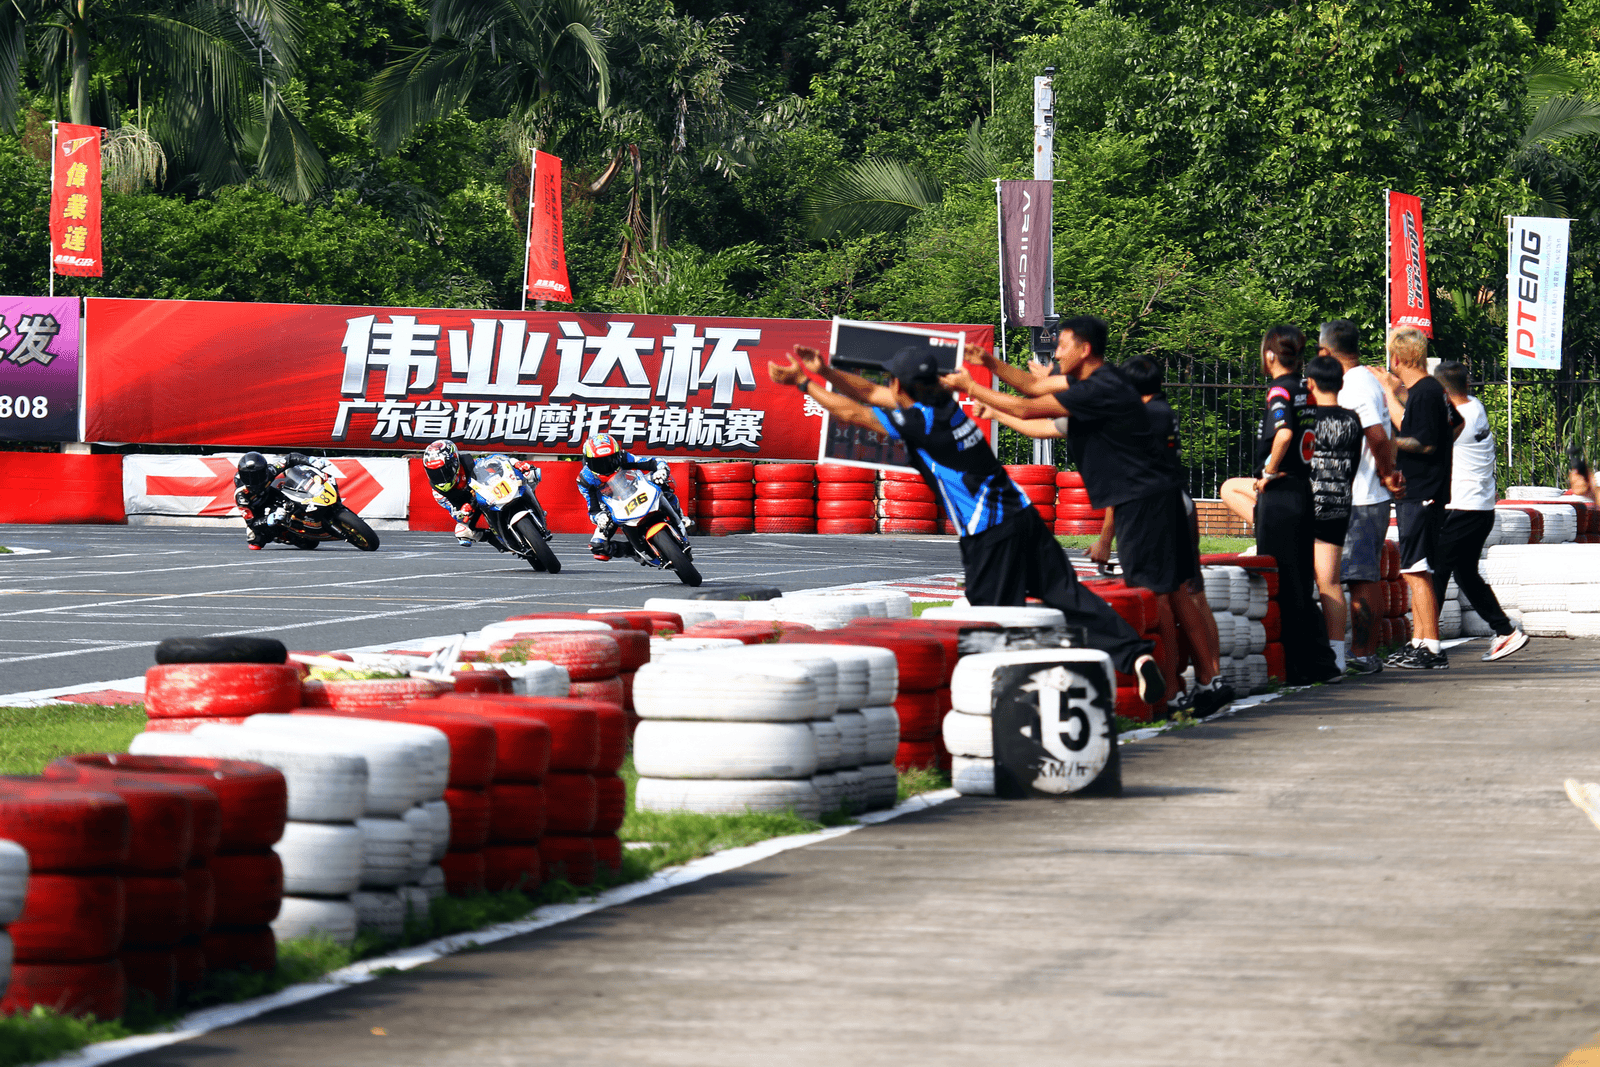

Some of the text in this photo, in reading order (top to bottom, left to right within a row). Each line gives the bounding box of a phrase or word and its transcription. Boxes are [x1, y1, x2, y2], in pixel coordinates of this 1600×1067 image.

[0, 315, 58, 365] 发
[340, 314, 762, 406] 伟业达杯
[331, 397, 765, 449] 广东省场地摩托车锦标赛
[319, 488, 335, 504] 81
[493, 482, 512, 499] 91
[624, 492, 648, 516] 136
